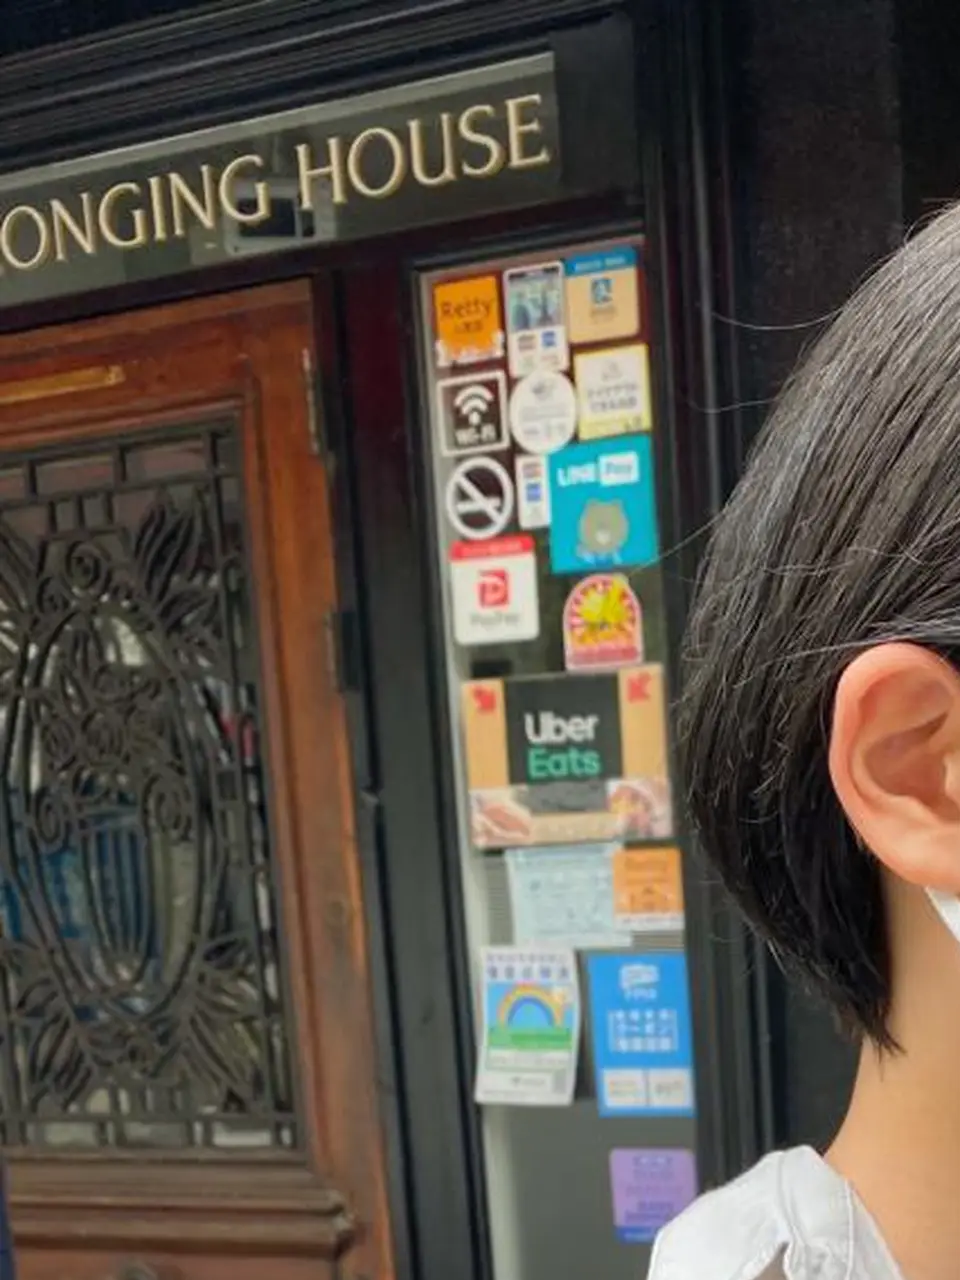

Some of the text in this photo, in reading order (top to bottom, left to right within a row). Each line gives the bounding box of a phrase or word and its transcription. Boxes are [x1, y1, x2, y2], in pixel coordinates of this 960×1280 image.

[0, 94, 551, 277] ONGING HOUSE
[524, 711, 599, 743] Uber
[527, 747, 601, 779] Eats
